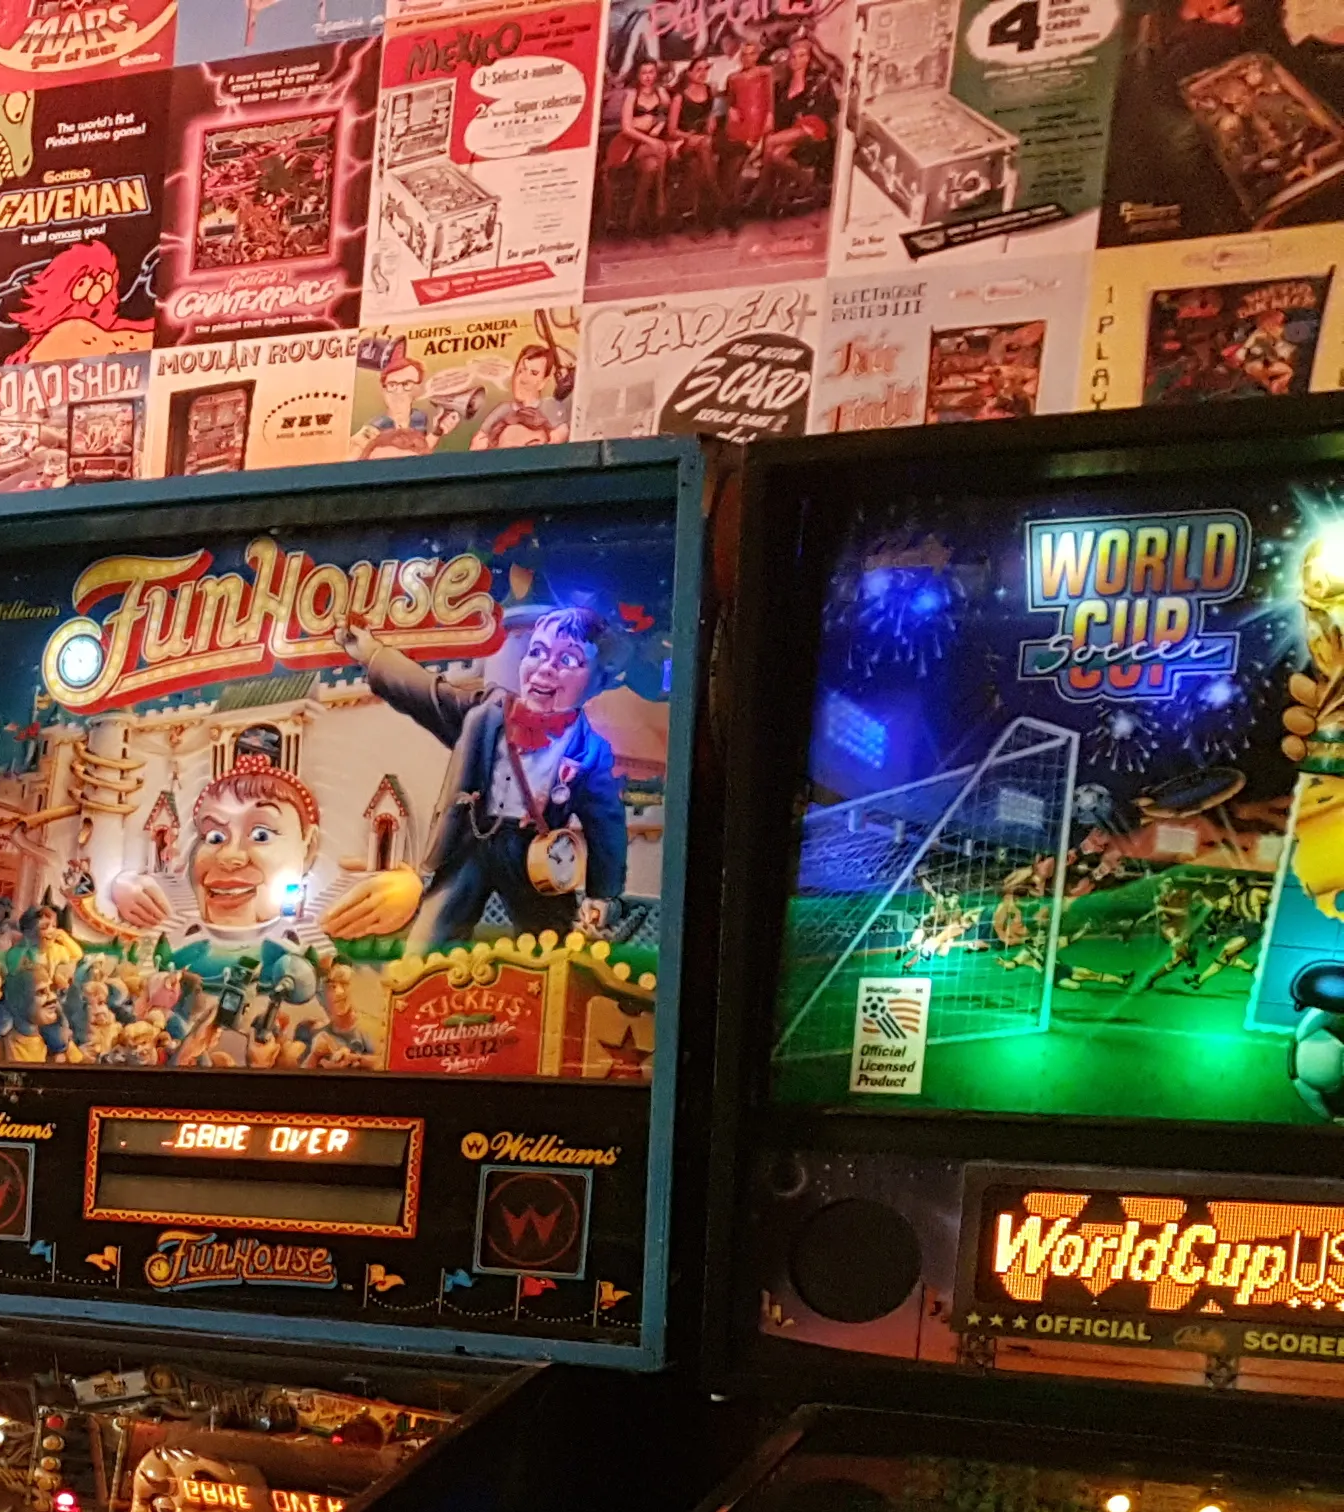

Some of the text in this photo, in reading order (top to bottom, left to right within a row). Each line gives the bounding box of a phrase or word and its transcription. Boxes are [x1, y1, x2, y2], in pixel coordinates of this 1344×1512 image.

[20, 4, 138, 53] MARS
[987, 1, 1041, 53] 4
[64, 48, 80, 63] of
[406, 22, 522, 79] MEXICO
[45, 122, 147, 149] Pinball Video game!
[57, 113, 136, 135] The world's first
[84, 223, 107, 240] you!
[174, 278, 337, 318] COUNTERFORCE
[408, 319, 518, 340] LIGHTS CAMERA
[595, 287, 800, 367] LEADER
[268, 334, 358, 365] ROUGE
[423, 333, 508, 356] ACTION!
[674, 357, 810, 413] 3 CARD
[281, 414, 333, 428] NEW
[1040, 521, 1236, 597] WORLD
[42, 537, 506, 713] FunHouse
[1036, 634, 1227, 676] Soccer
[1066, 597, 1194, 691] CUP
[419, 988, 525, 1018] TICKETS
[413, 1020, 516, 1045] Funhouse
[405, 1042, 461, 1059] CLOSES
[859, 1058, 916, 1073] Licensed
[861, 1044, 907, 1057] Official
[857, 1074, 907, 1088] Product
[176, 1123, 350, 1154] GAME OVER
[490, 1129, 620, 1167] Williams
[145, 1231, 338, 1291] FunHouse
[1035, 1314, 1344, 1358] OFFICIAL SCORE
